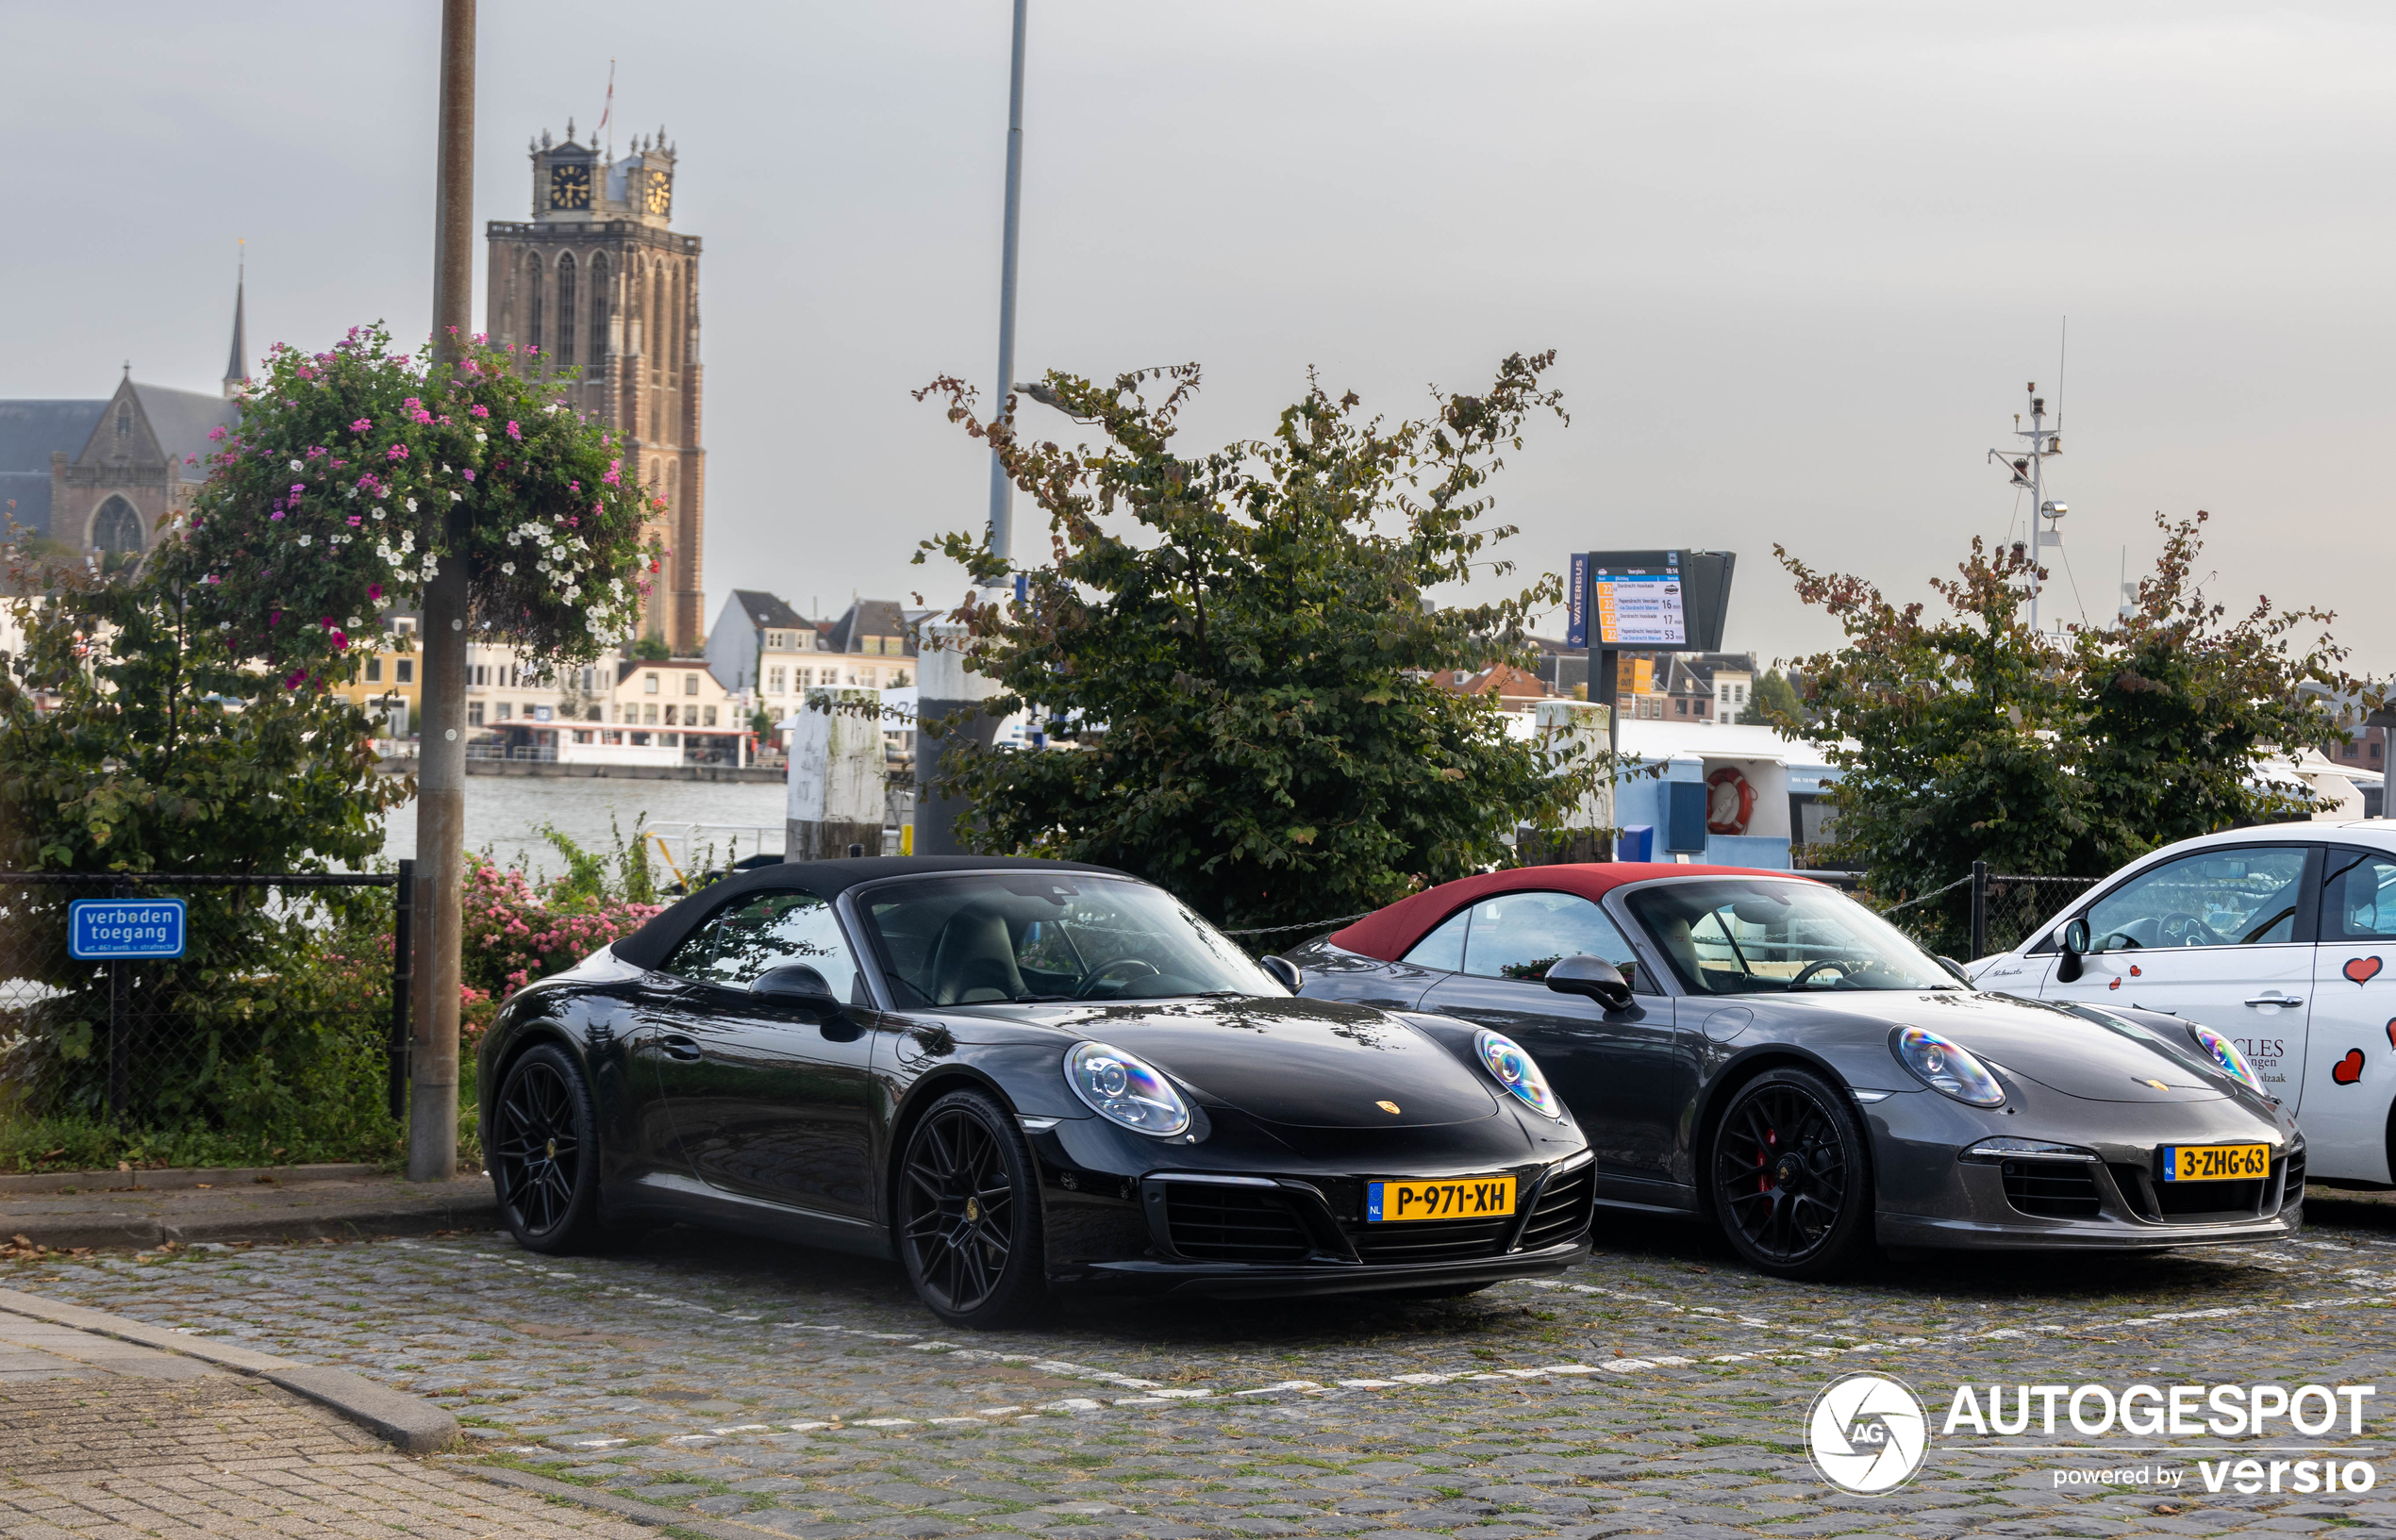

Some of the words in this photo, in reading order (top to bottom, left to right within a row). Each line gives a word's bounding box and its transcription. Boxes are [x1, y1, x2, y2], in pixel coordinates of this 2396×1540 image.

[1573, 559, 1583, 626] WATERBUS
[1603, 585, 1613, 594] 22
[1605, 600, 1614, 609] 22
[1662, 599, 1672, 609] 16
[1606, 615, 1616, 624] 22
[1663, 614, 1672, 624] 17
[1607, 630, 1617, 639] 22
[1664, 630, 1674, 640] 53
[86, 908, 172, 924] verboden
[92, 925, 166, 943] toegang
[2184, 1149, 2264, 1176] 3-ZHG-63
[1397, 1183, 1506, 1216] P-971-XH
[1370, 1206, 1381, 1215] NL
